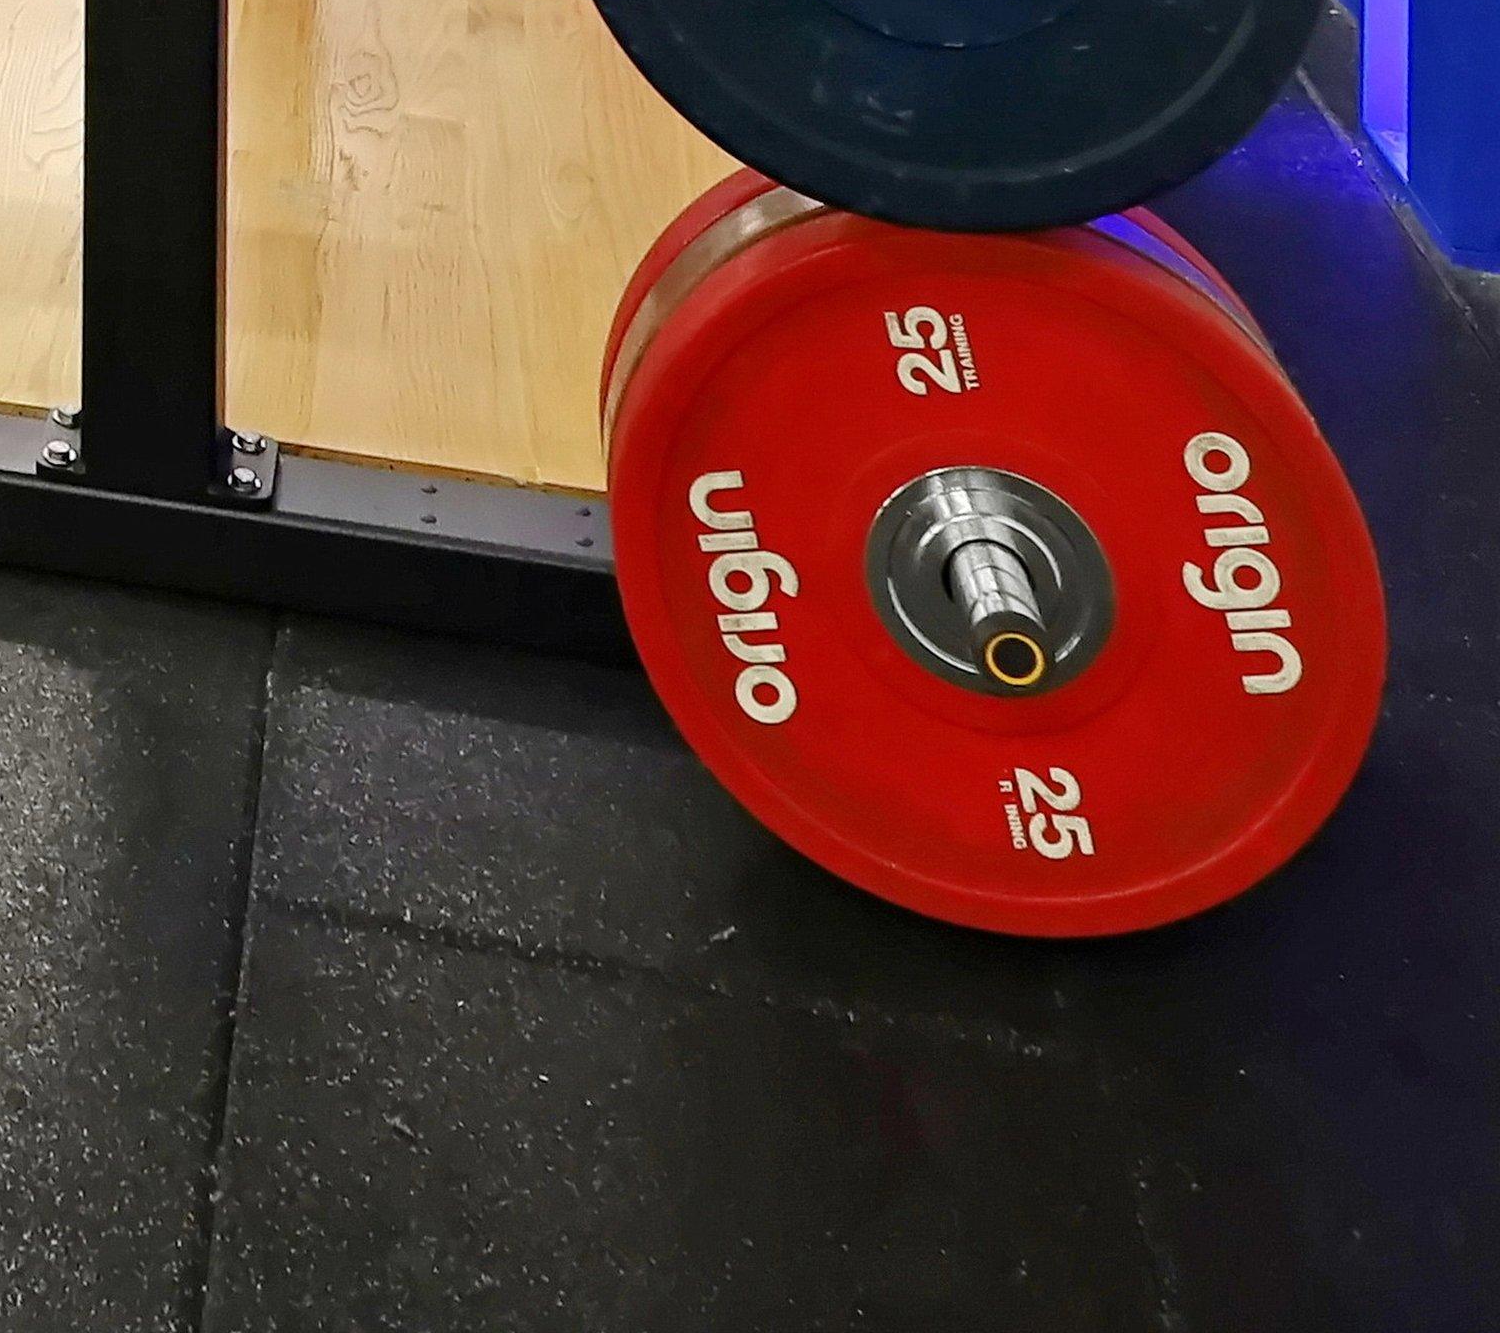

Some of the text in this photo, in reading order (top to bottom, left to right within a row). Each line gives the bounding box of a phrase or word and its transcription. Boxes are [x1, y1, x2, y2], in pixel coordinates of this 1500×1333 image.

[883, 306, 962, 395] 25
[949, 313, 980, 391] TRAINING
[688, 470, 799, 725] origin
[1183, 431, 1303, 695] origin
[1014, 766, 1096, 860] 25
